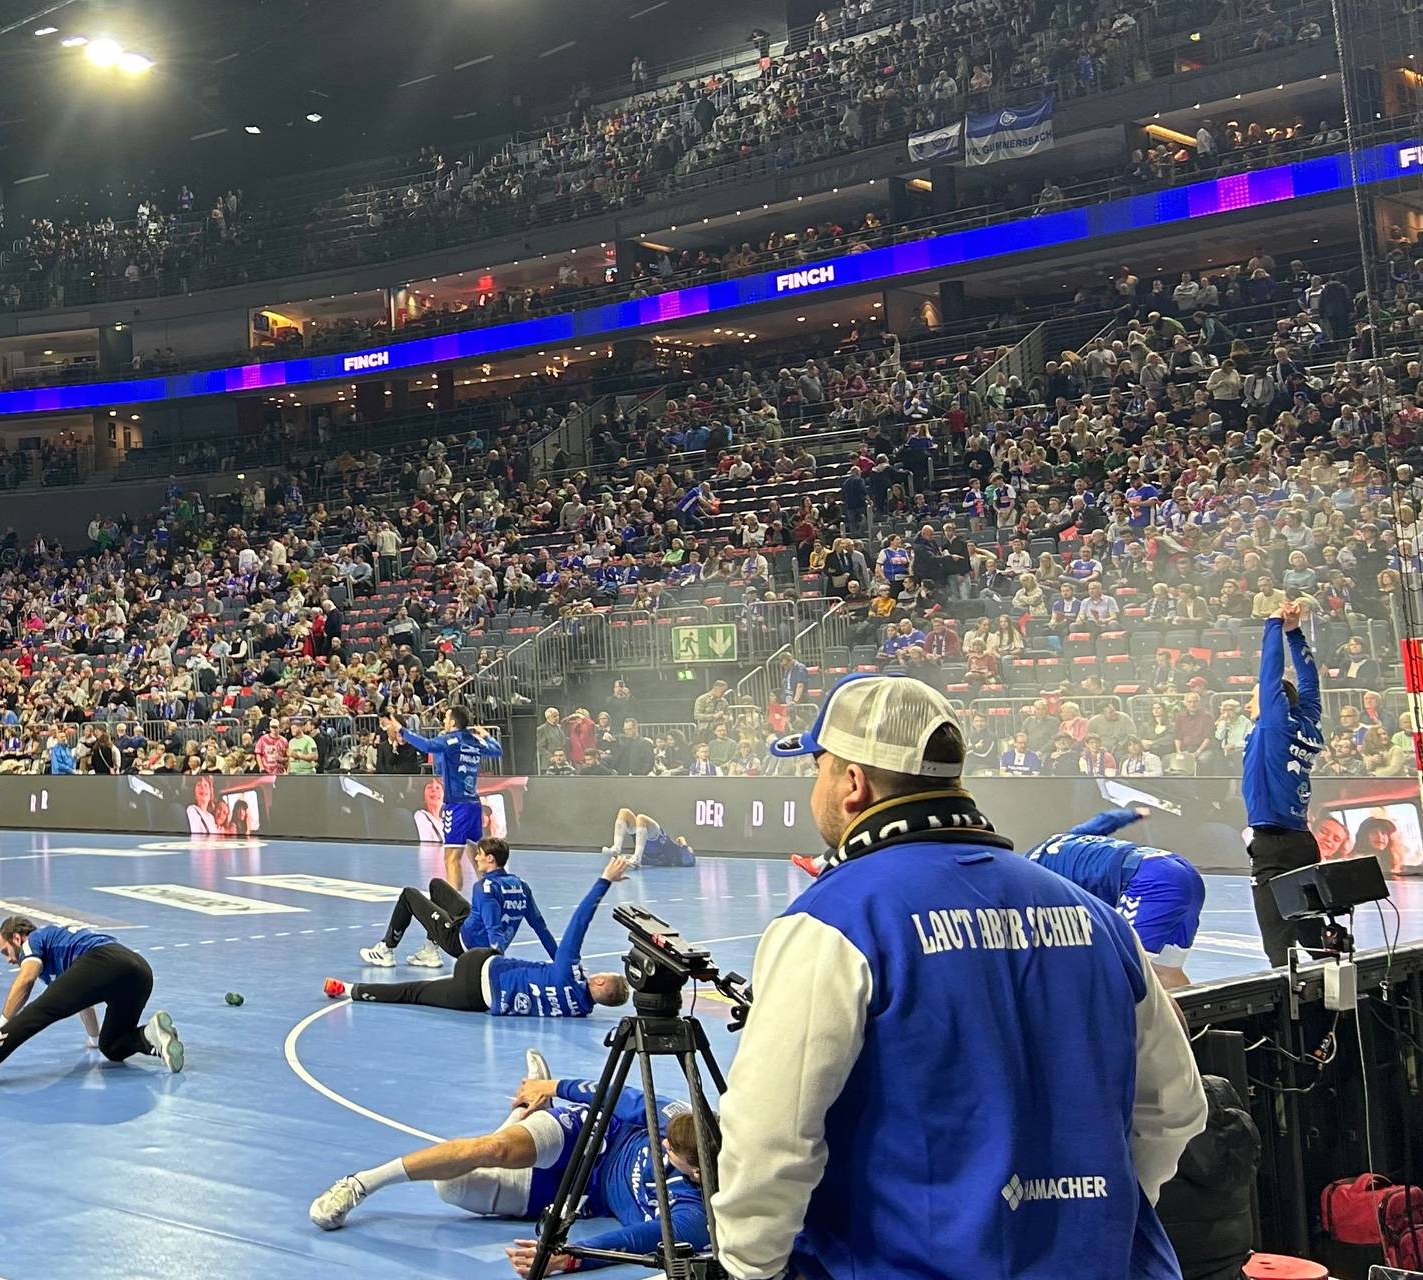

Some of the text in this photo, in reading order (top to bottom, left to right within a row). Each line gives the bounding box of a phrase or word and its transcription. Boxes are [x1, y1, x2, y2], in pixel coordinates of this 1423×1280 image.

[776, 264, 834, 292] FINCH
[343, 350, 389, 371] FINCH
[696, 799, 724, 827] DER
[911, 905, 1094, 955] LAUT ABER SCHIEF
